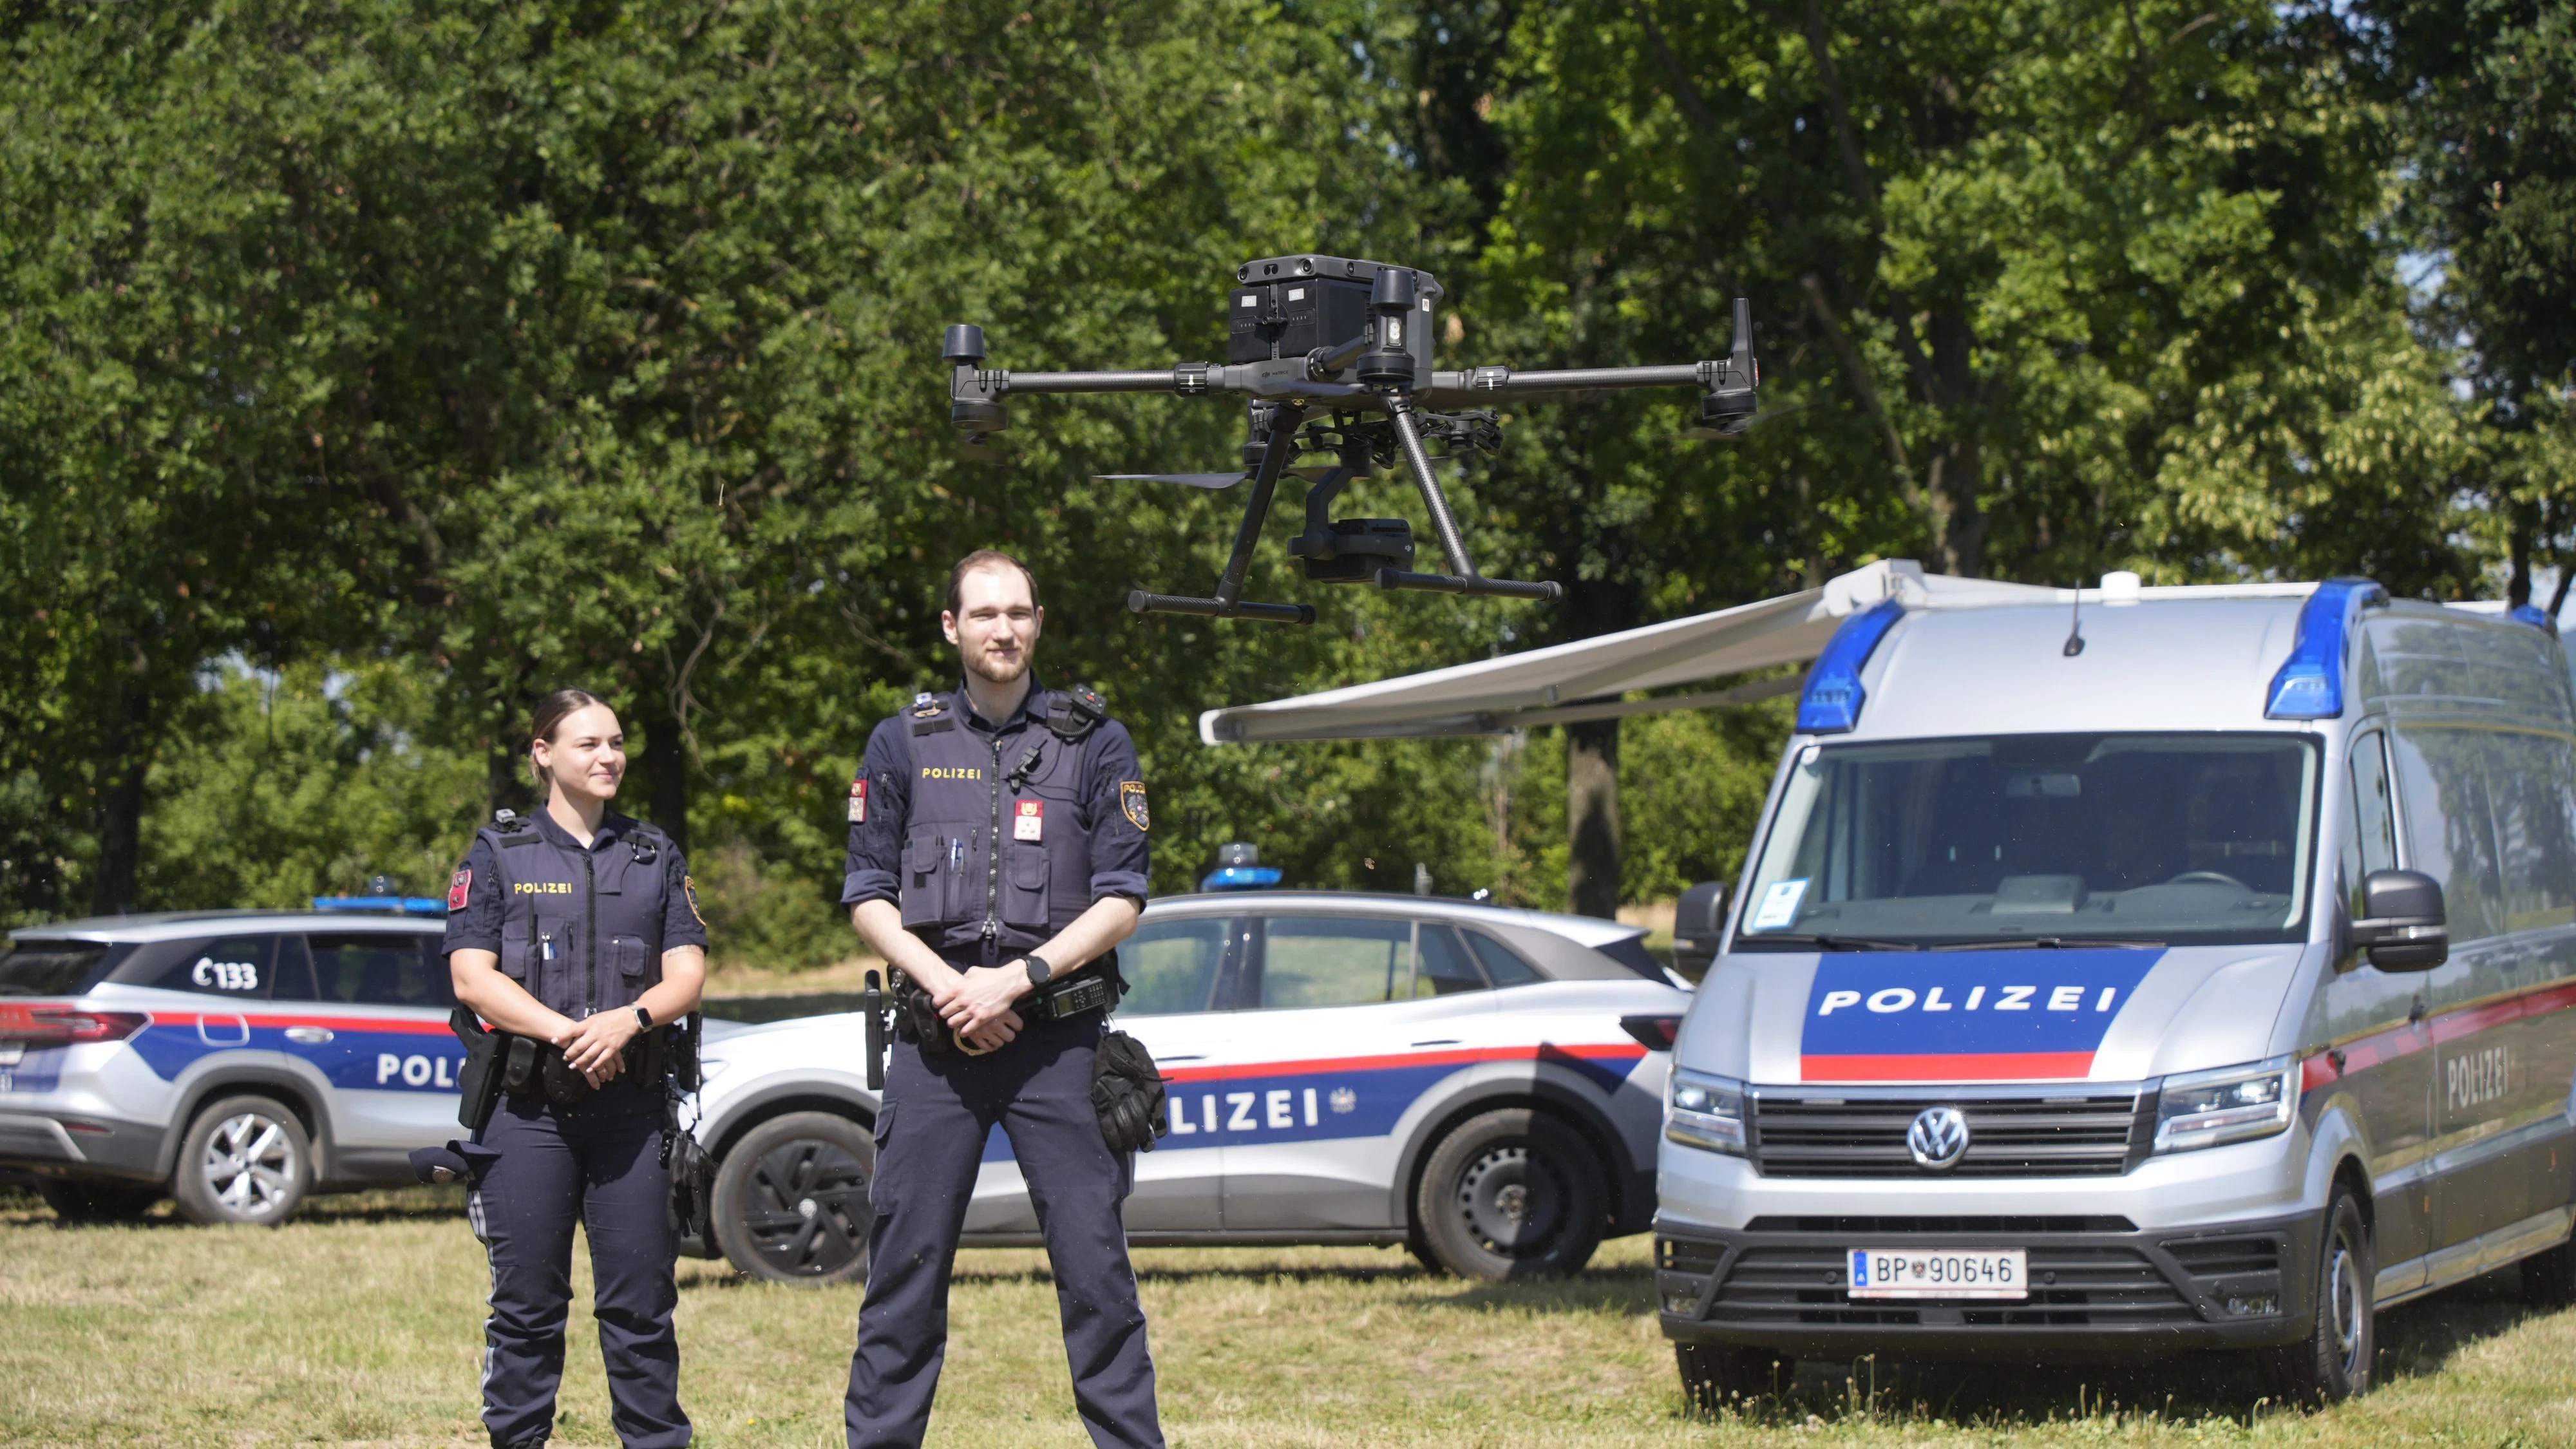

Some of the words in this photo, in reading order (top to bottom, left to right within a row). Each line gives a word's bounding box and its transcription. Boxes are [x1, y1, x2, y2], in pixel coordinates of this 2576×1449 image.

[922, 768, 981, 780] POLIZEI
[515, 882, 572, 895] POLIZEI
[212, 962, 258, 990] 133
[1818, 986, 2116, 1016] POLIZEI
[2447, 1045, 2509, 1110] POLIZEI
[1877, 1258, 1906, 1282] BP
[1929, 1257, 2012, 1282] 90646
